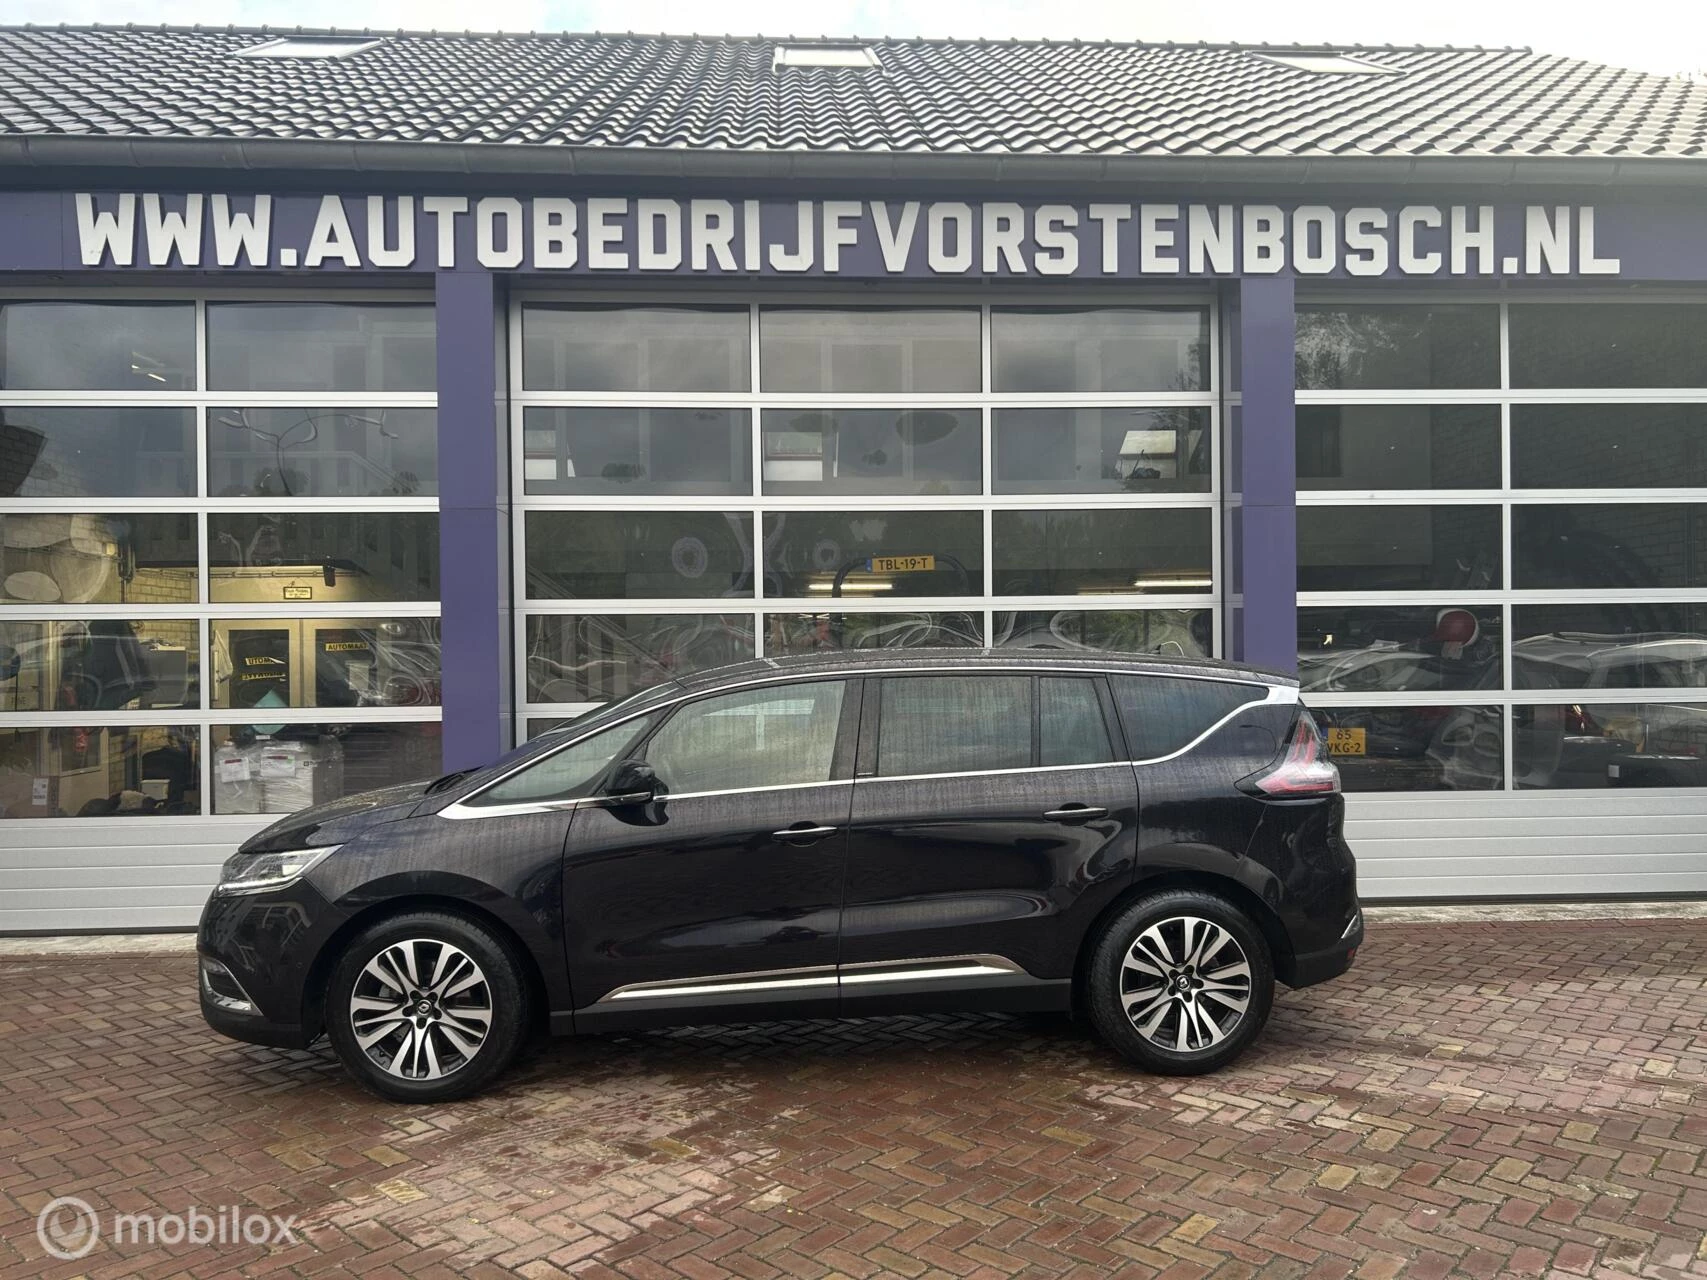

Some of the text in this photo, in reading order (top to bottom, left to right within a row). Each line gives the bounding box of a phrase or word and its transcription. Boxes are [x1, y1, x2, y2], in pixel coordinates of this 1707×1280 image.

[75, 192, 1621, 276] WWW.AUTOBEDRIJFVORSTENBOSCH.NL
[878, 558, 928, 570] TBL-19-T
[1336, 729, 1352, 740] 65
